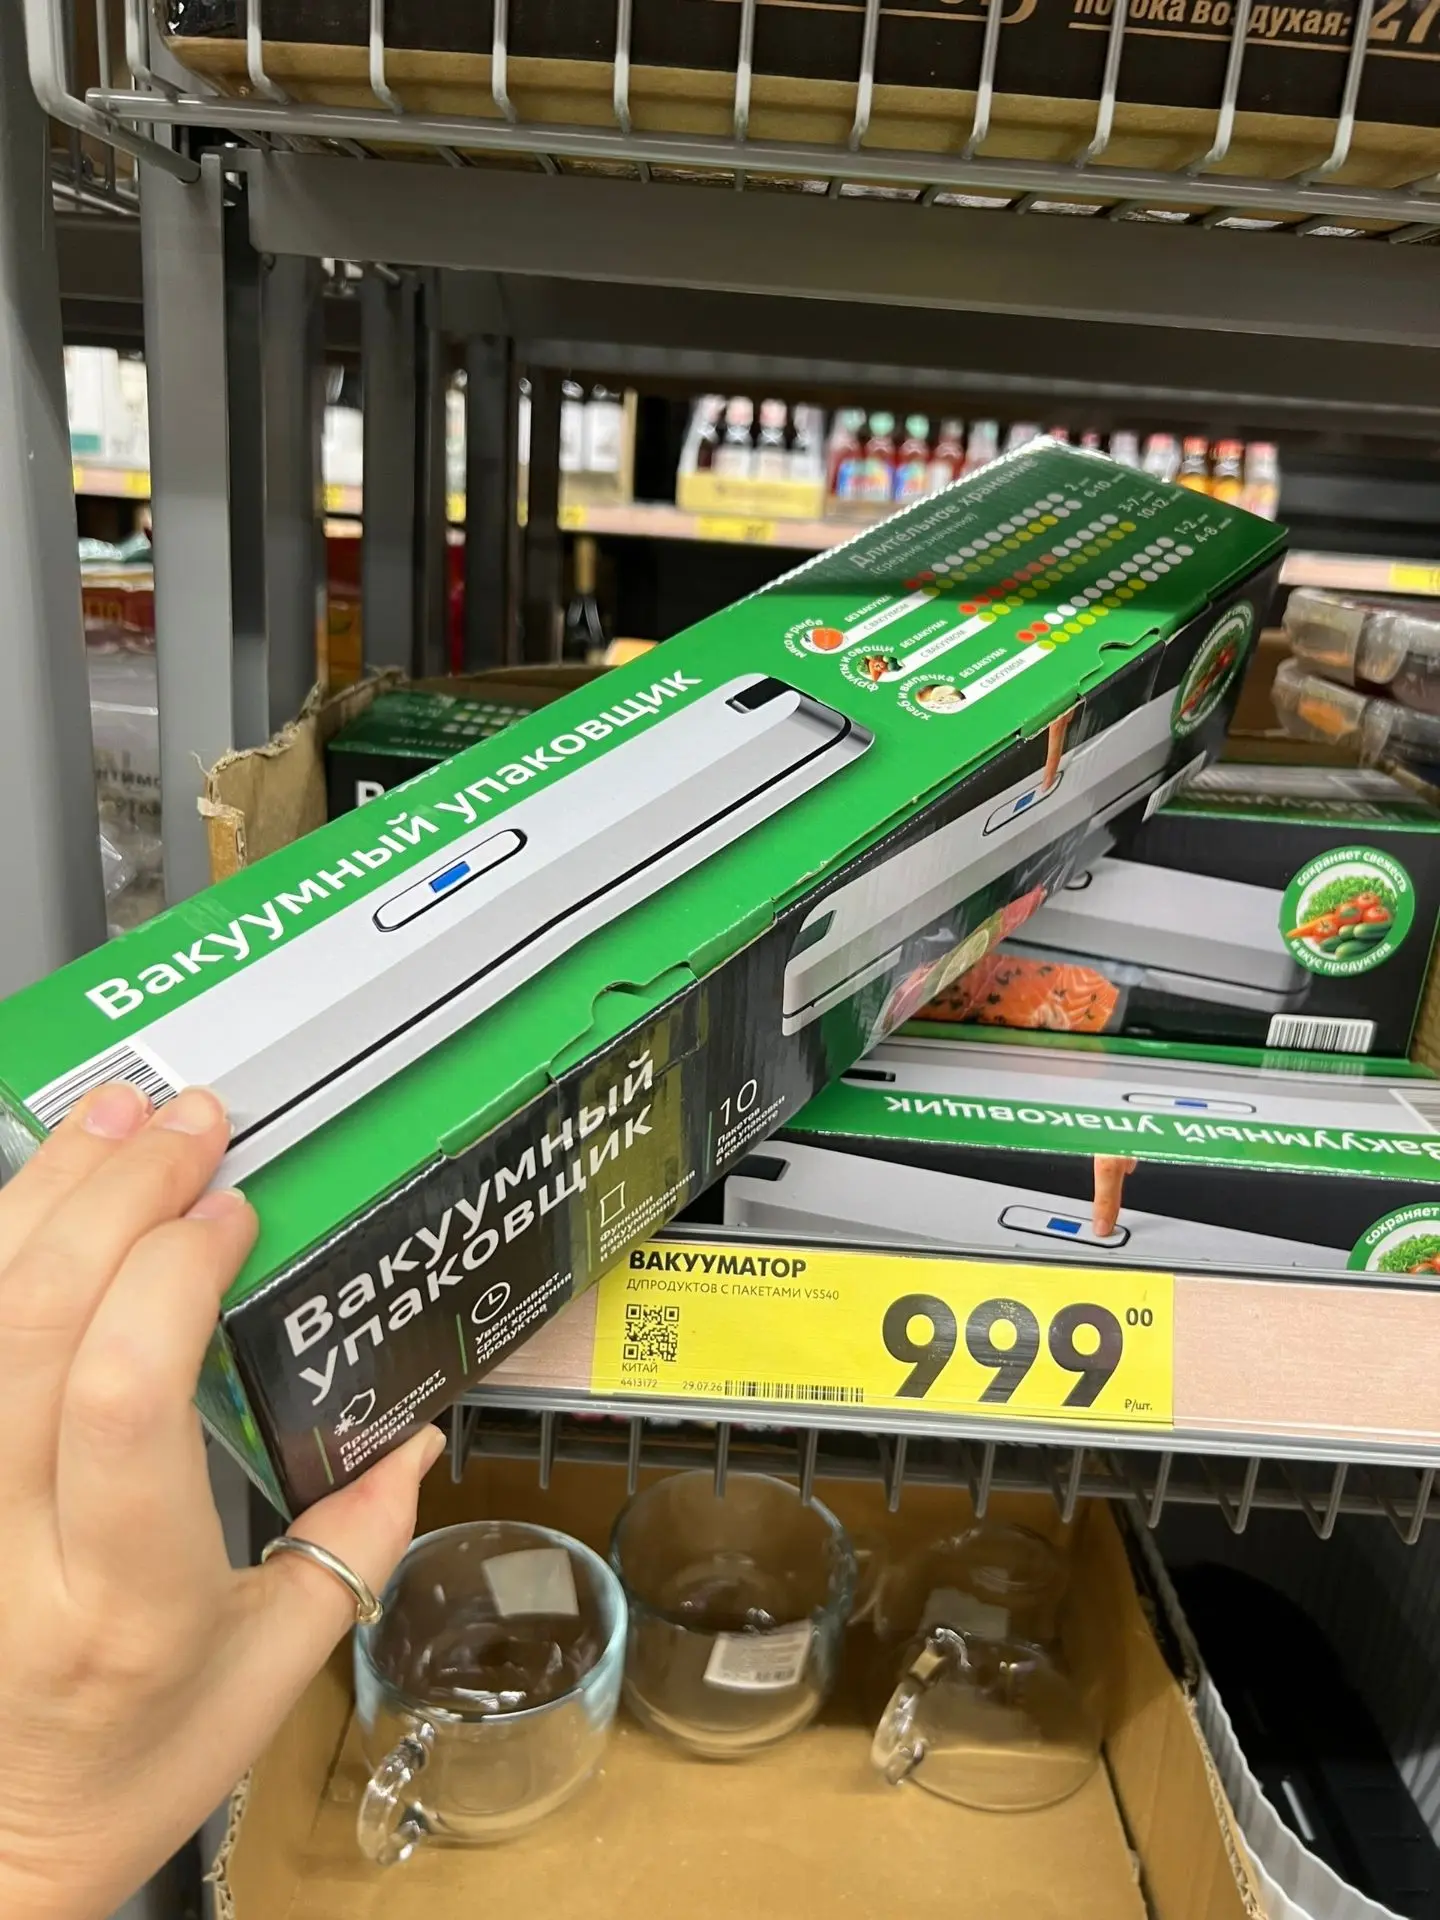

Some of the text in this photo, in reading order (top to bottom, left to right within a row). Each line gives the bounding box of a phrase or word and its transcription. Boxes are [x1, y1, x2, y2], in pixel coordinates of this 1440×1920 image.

[1074, 0, 1351, 38] поока водухая:
[849, 457, 1039, 569] Длительное хранение
[870, 512, 979, 575] (средние значения)
[790, 618, 824, 634] рыба
[848, 645, 895, 657] овощи
[900, 674, 955, 692] выпечка
[897, 699, 931, 720] хлеб
[84, 668, 703, 1021] Вакуумный упаковщик
[1297, 850, 1407, 893] сохраняет свежесть
[1290, 939, 1392, 973] и вкус продуктов
[716, 1095, 785, 1157] для упаковки
[717, 1107, 760, 1146] Пакетов
[720, 1079, 757, 1126] 10
[883, 1096, 1164, 1134] упаковщик
[724, 1109, 779, 1160] комплекте
[283, 1049, 653, 1357] Вакуумный
[600, 1170, 695, 1253] вакуумирования
[600, 1195, 653, 1242] Функции
[1365, 1207, 1440, 1245] сохраняет
[600, 1194, 677, 1262] и запаивания
[299, 1104, 653, 1406] упаковщик
[629, 1250, 807, 1278] ВАКУУМАТОР
[475, 1272, 560, 1345] Увеличивает
[626, 1278, 717, 1294] Д/ПРОДУКТОВ
[721, 1284, 729, 1295] С
[732, 1285, 801, 1298] ПАКЕТАМИ
[476, 1272, 573, 1355] срок хранения
[477, 1303, 548, 1365] продуктов
[621, 1361, 658, 1373] КИТАЙ
[882, 1293, 1153, 1408] 999 00
[620, 1378, 723, 1392] 4413172 29.07.26
[340, 1369, 442, 1456] Препятствует
[342, 1376, 447, 1466] размножению
[344, 1412, 415, 1473] бактерий
